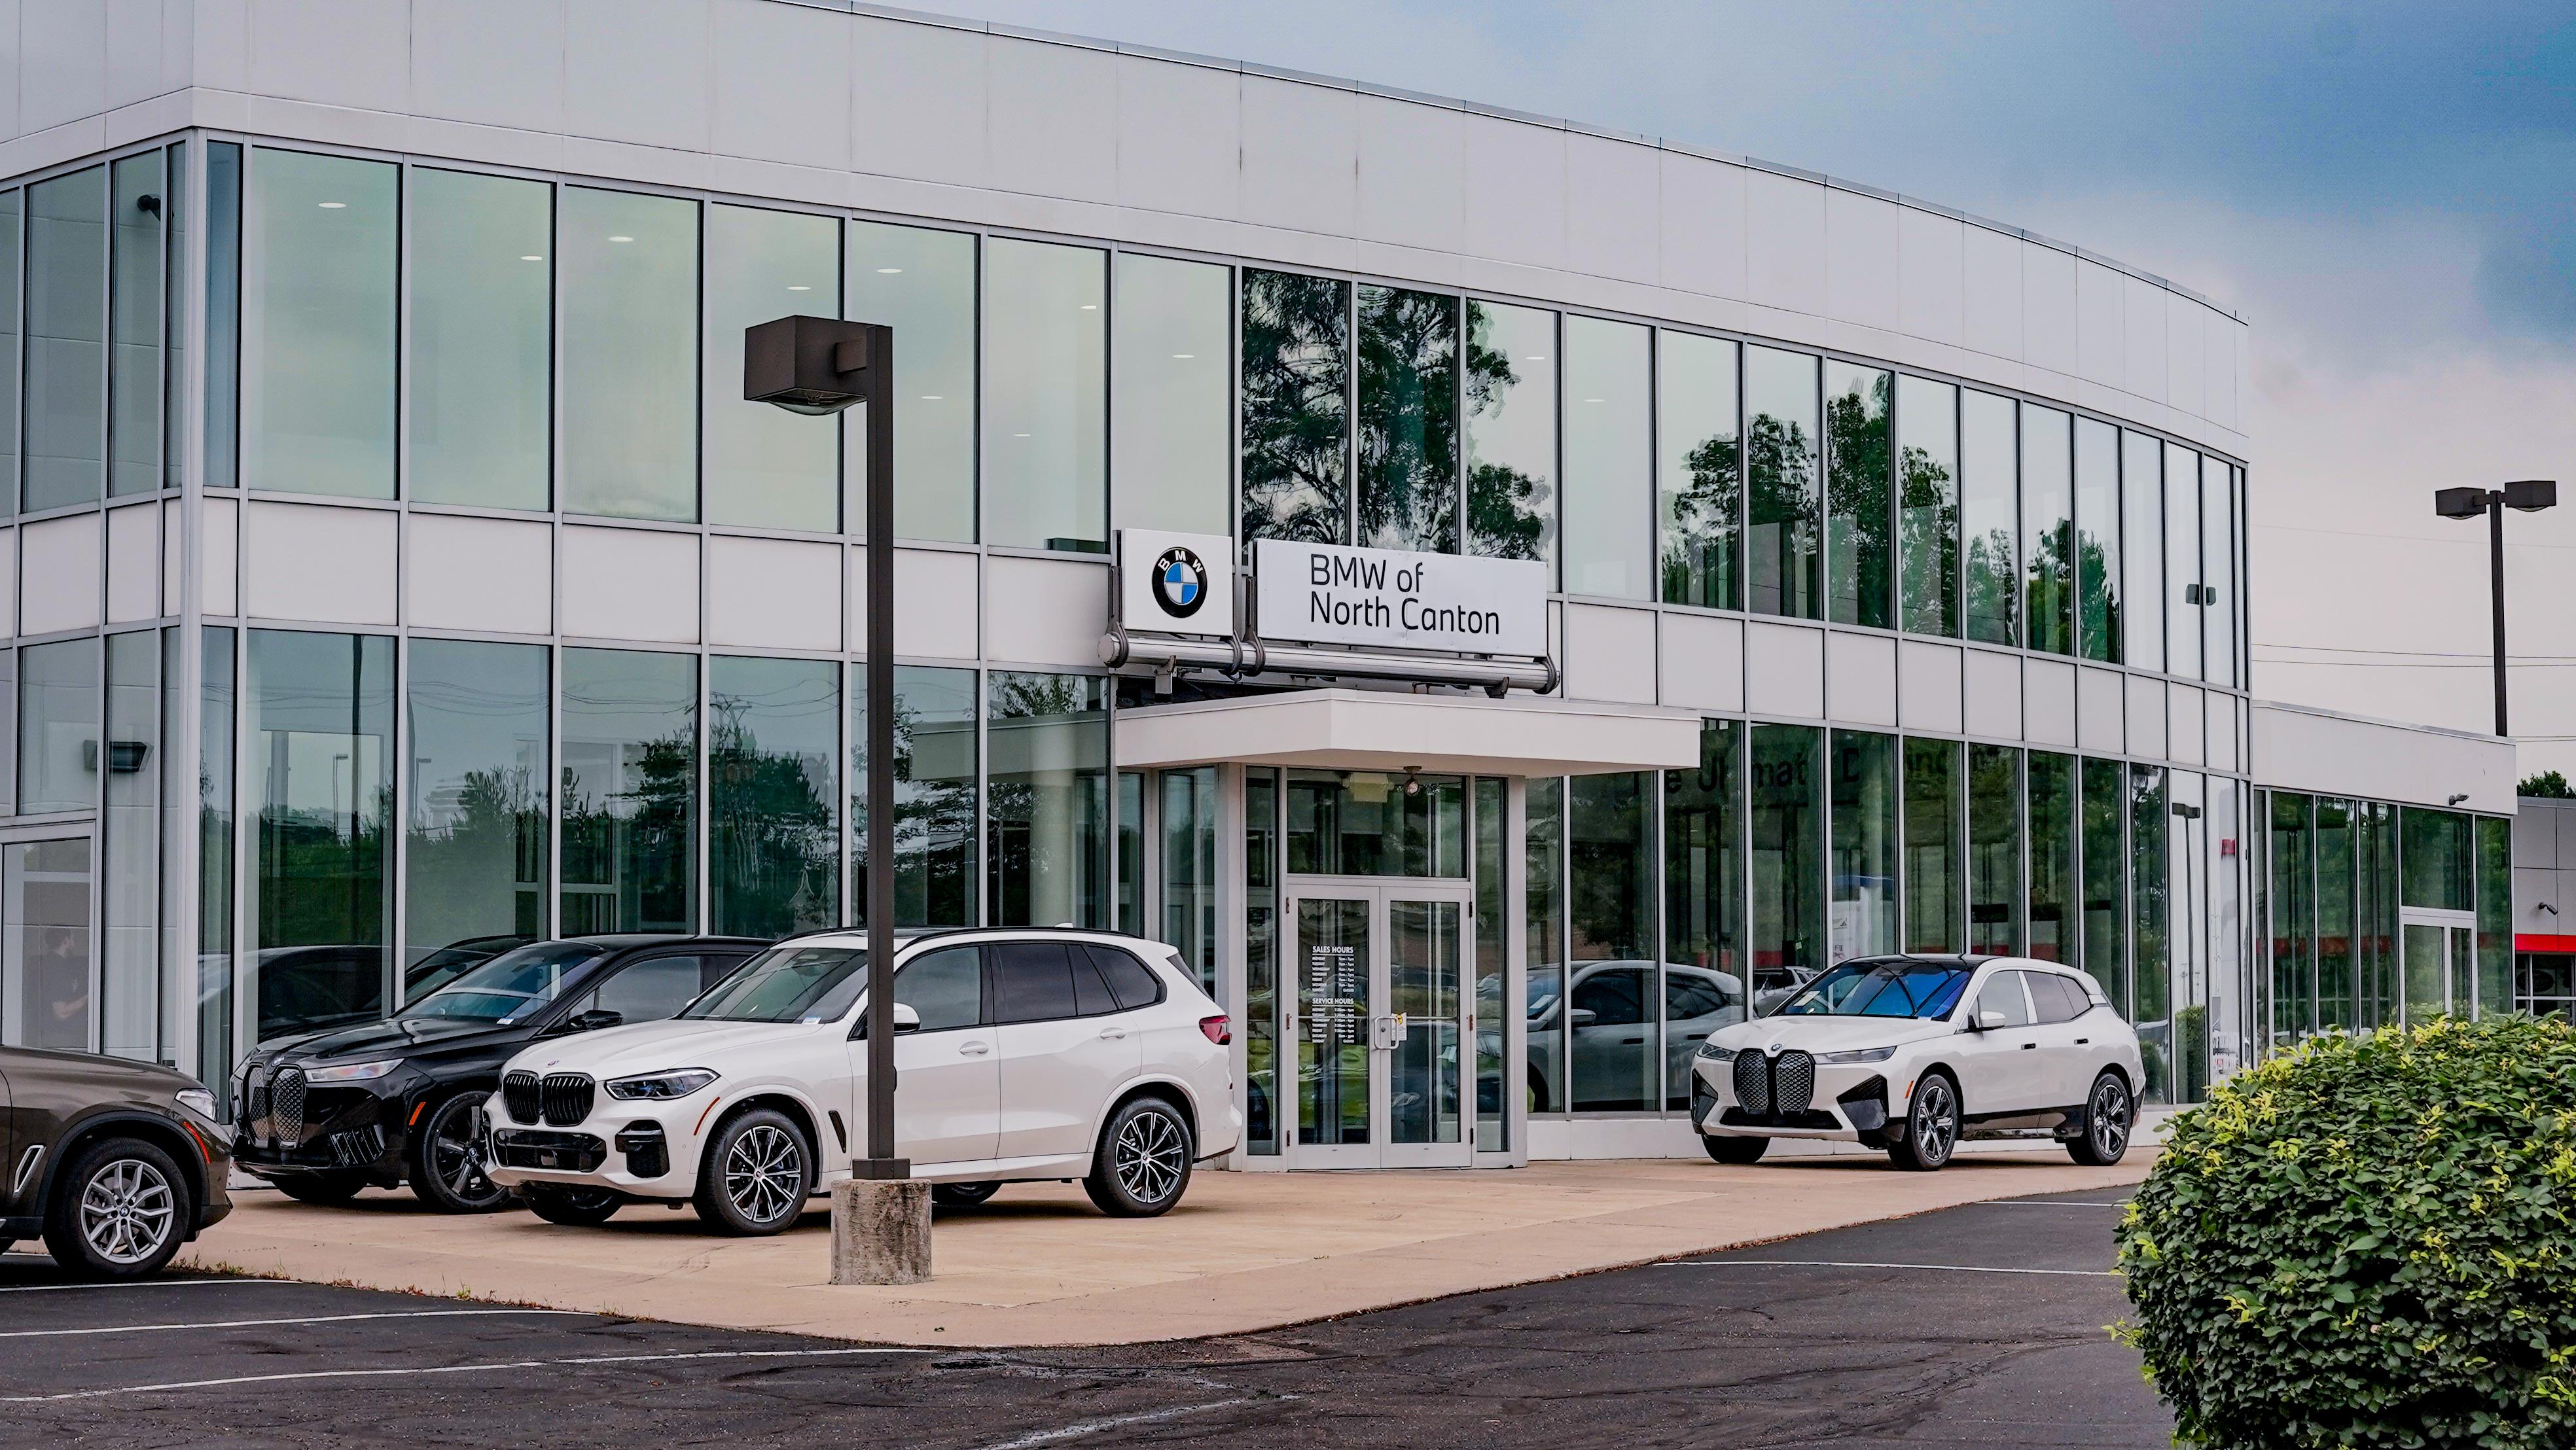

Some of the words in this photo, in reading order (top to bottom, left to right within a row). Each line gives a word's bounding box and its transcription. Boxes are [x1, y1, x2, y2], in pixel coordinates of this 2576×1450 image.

[1157, 550, 1204, 573] BMW
[1311, 554, 1386, 590] BMW
[1398, 561, 1423, 593] of
[1311, 591, 1390, 628] North
[1401, 598, 1500, 634] Canton
